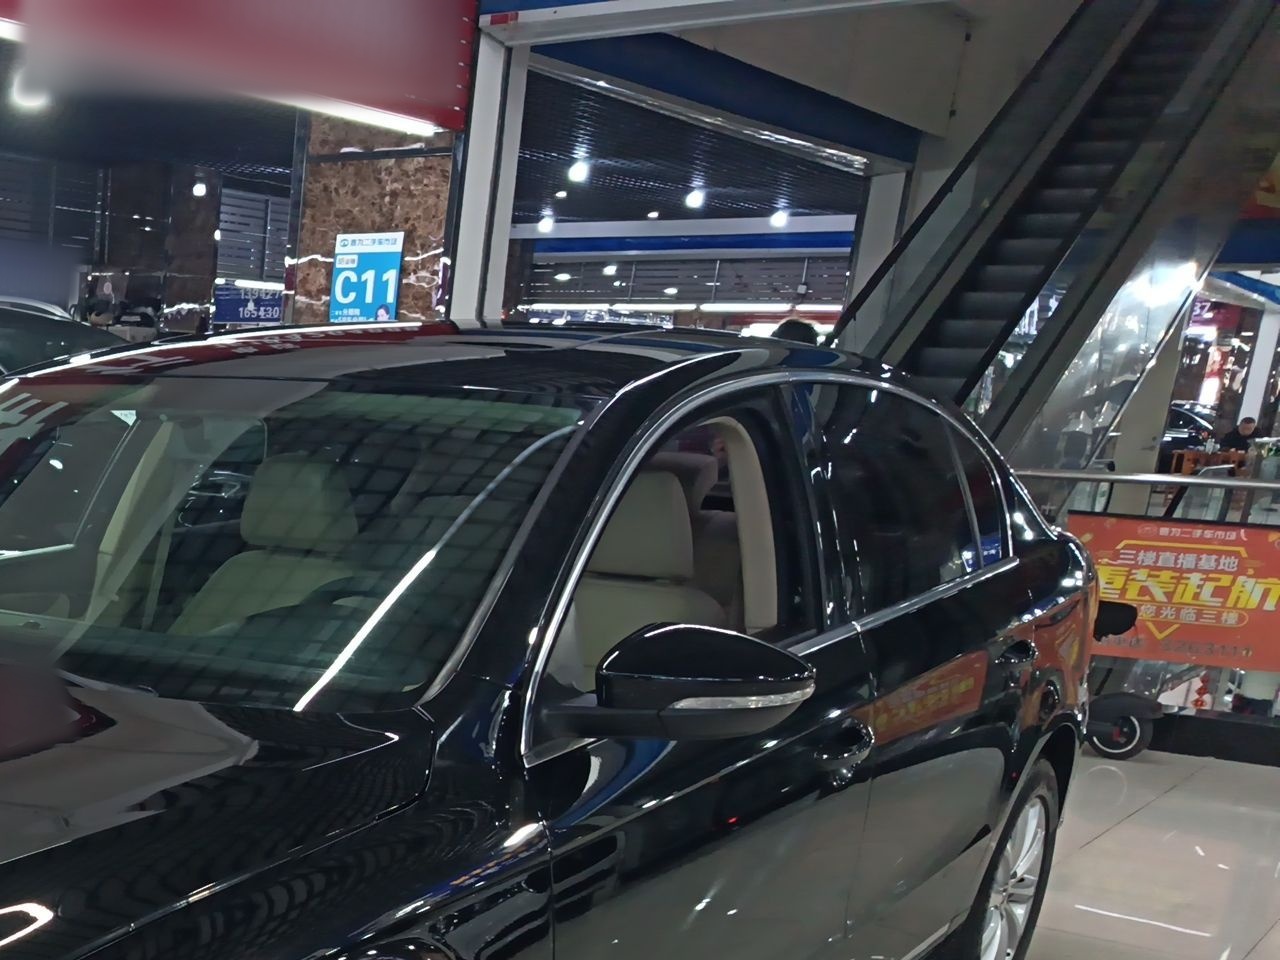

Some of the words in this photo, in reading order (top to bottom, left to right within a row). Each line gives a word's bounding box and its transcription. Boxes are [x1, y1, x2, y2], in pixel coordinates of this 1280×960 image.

[334, 268, 397, 305] C11
[1120, 550, 1239, 572] 三楼直播基地
[1096, 564, 1280, 611] 重装起航
